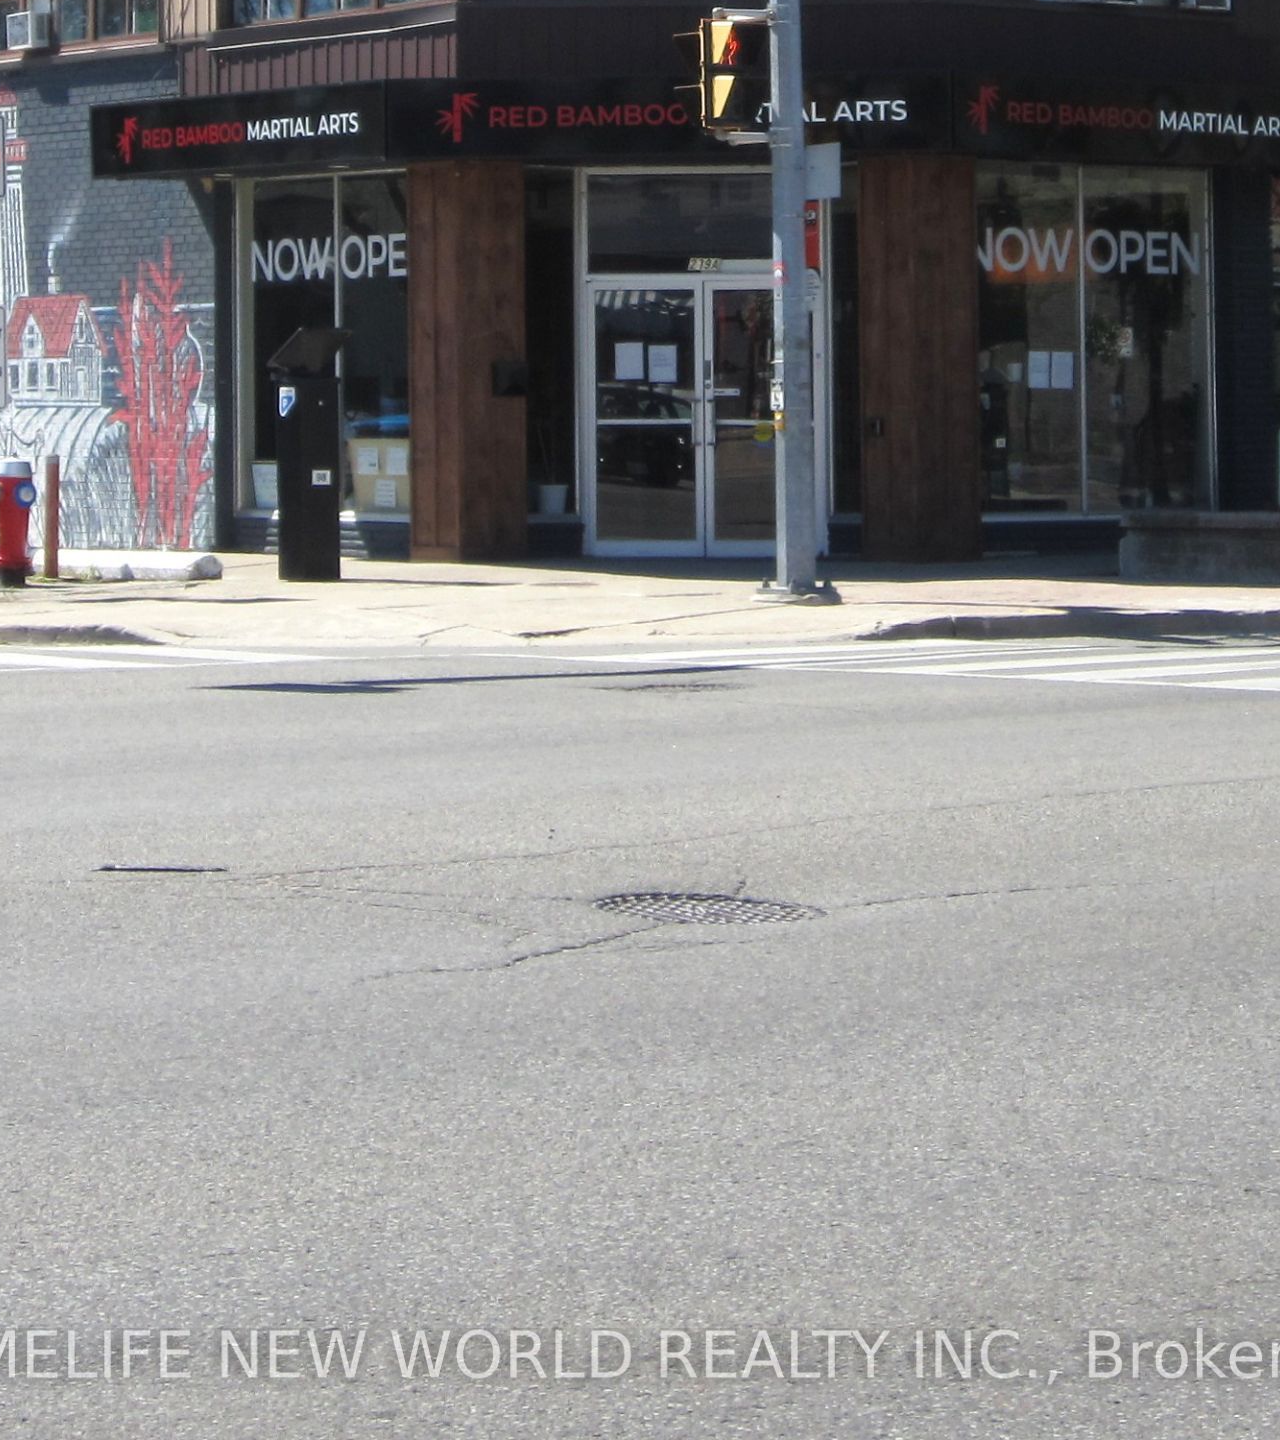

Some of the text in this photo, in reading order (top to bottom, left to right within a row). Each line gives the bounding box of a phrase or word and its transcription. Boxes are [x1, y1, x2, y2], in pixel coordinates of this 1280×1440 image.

[141, 112, 358, 149] RED BAMBOO MARTIAL ARTS
[489, 106, 547, 127] RED
[557, 104, 688, 127] BAMBOO
[833, 100, 907, 122] ARTS
[1007, 102, 1052, 124] RED
[1058, 104, 1153, 129] BAMBOO
[1159, 110, 1248, 135] MARTIAL
[251, 233, 407, 282] NOW OPE
[1085, 229, 1200, 275] OPEN
